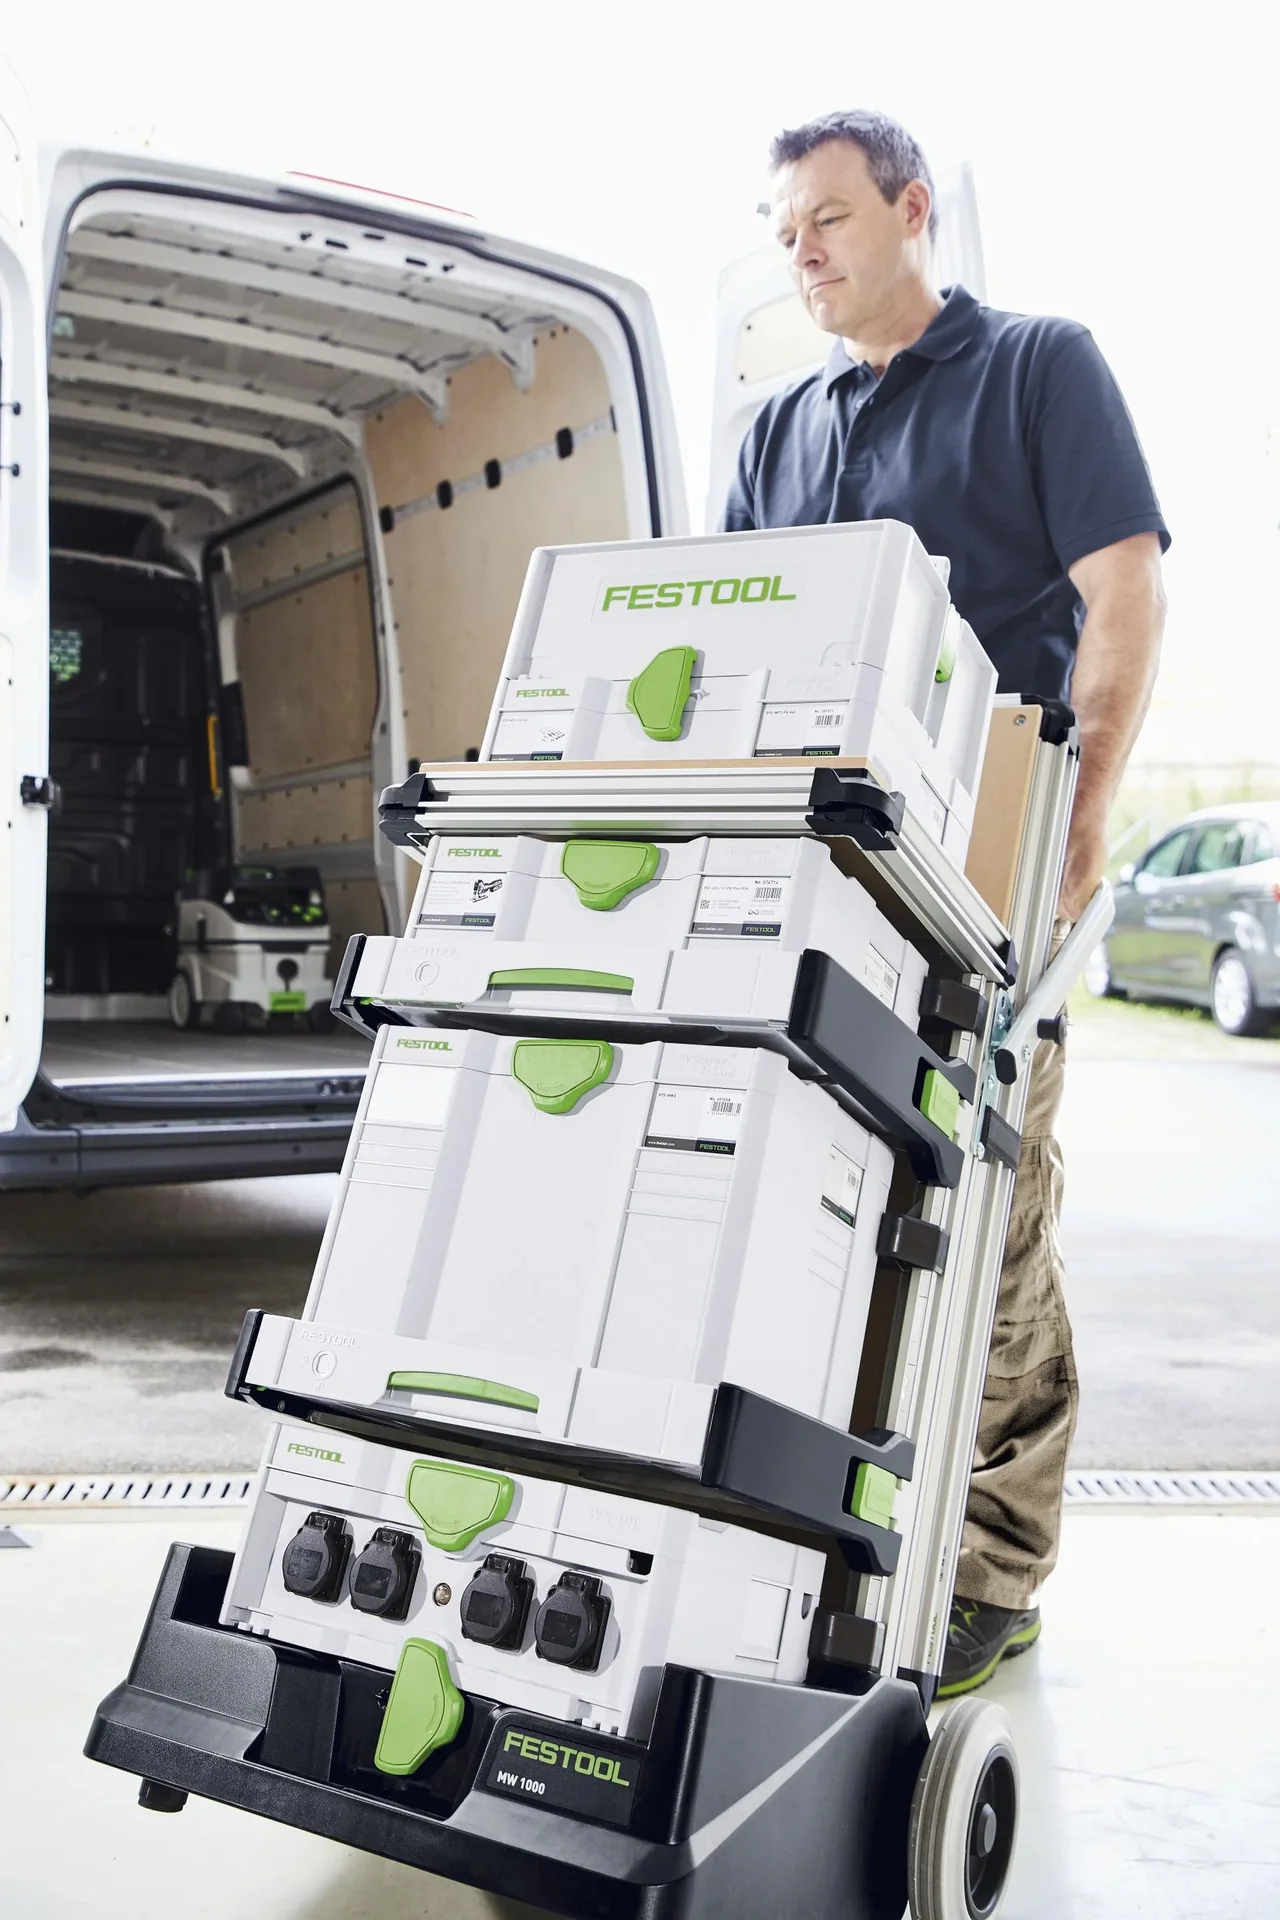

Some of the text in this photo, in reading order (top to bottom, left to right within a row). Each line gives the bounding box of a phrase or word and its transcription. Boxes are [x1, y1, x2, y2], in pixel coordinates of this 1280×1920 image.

[601, 576, 797, 611] FESTOOL
[516, 688, 570, 698] FESTOOL
[447, 848, 503, 857] FESTOOL
[396, 1039, 453, 1051] FESTOOL
[699, 1143, 731, 1152] FESTOOL
[287, 1443, 346, 1464] FESTOOL
[503, 1731, 630, 1787] FESTOOL
[497, 1770, 546, 1795] MW 1000
